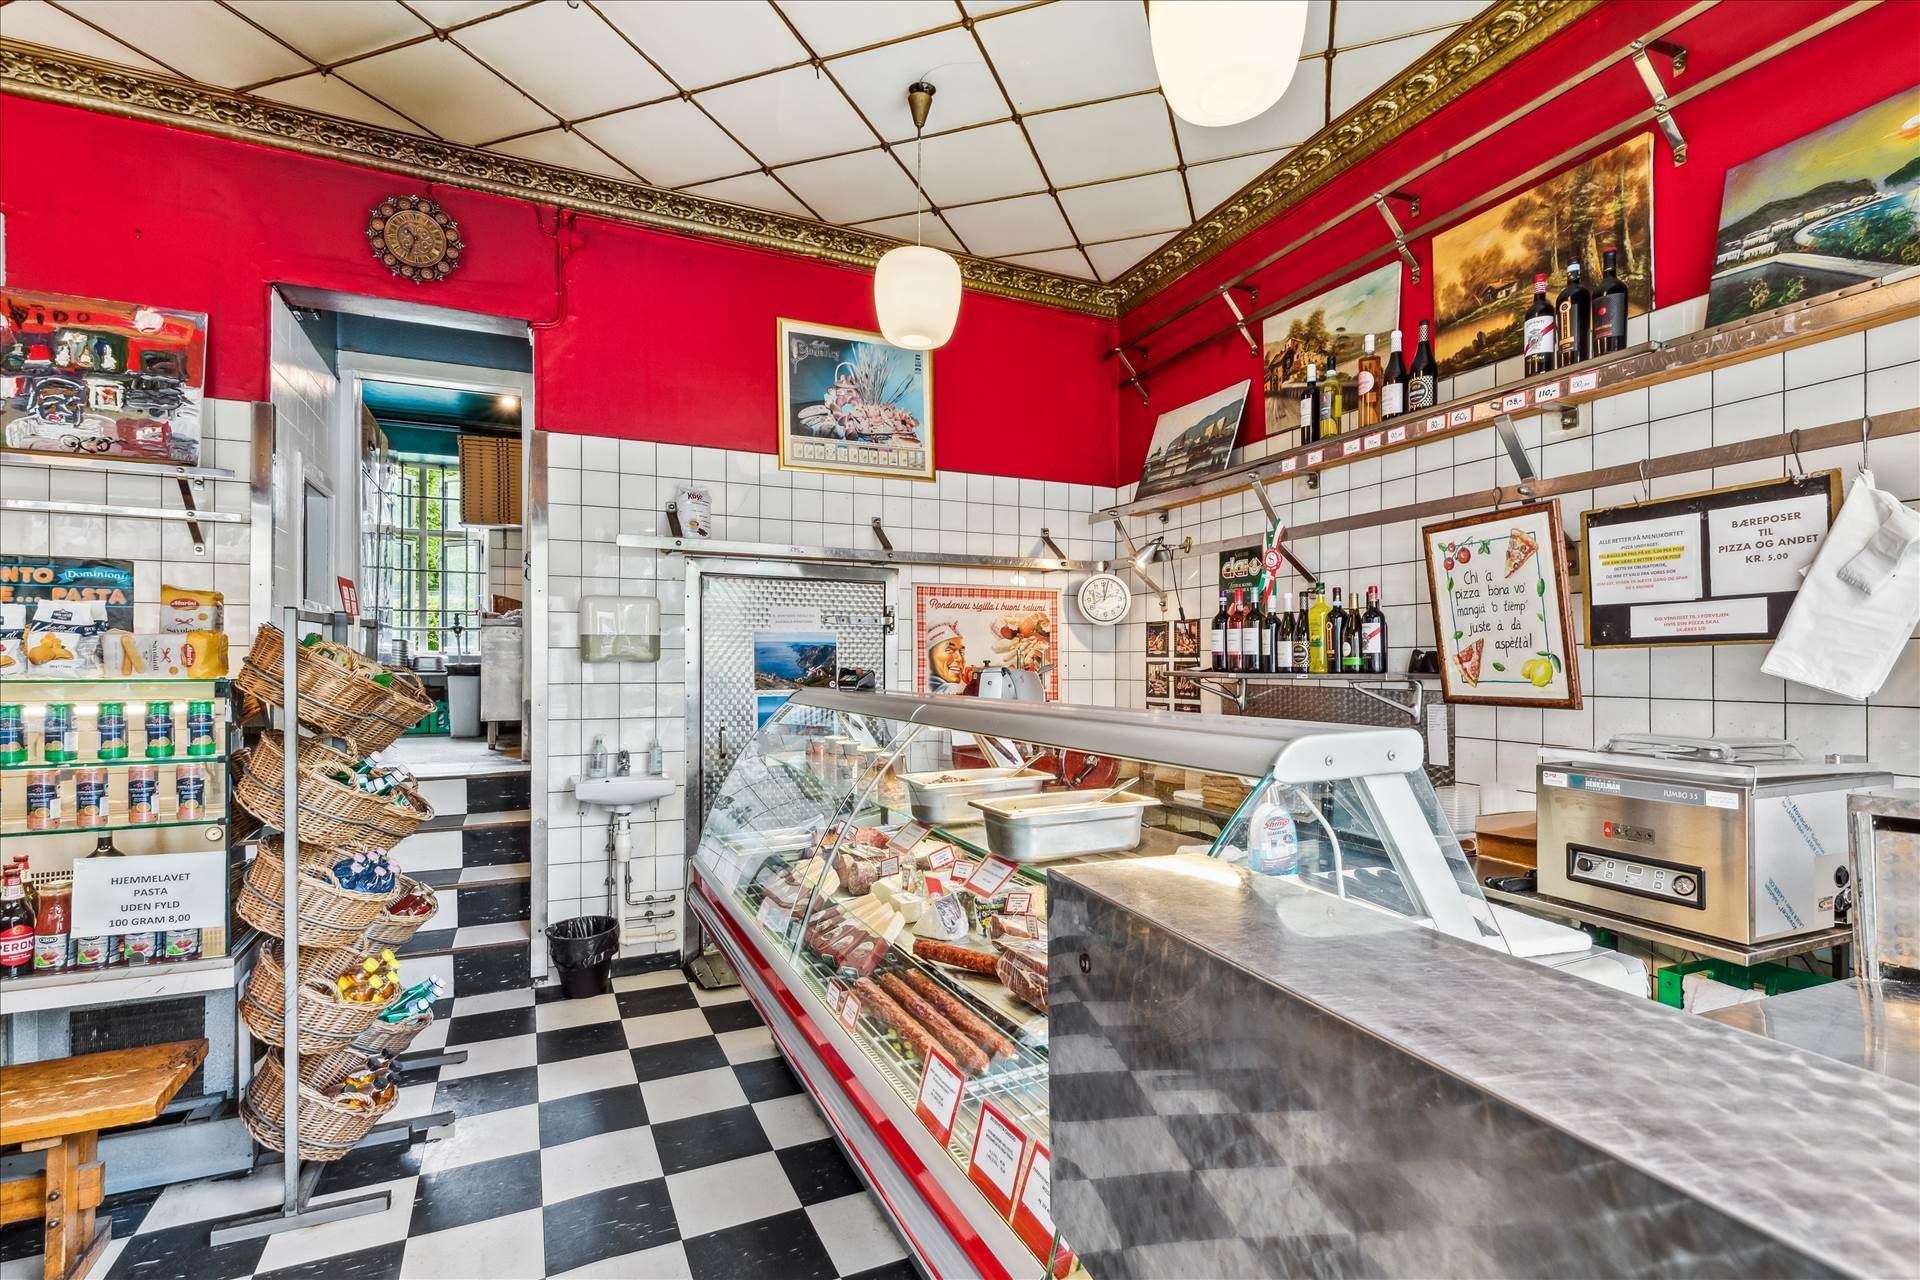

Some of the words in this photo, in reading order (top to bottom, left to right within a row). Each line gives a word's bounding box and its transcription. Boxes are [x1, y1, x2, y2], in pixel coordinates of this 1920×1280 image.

[1731, 511, 1801, 528] BÆREPOSER
[1642, 530, 1684, 541] MENUKORTET
[1758, 528, 1773, 536] TIL
[1718, 542, 1751, 553] PIZZA
[1755, 539, 1774, 549] OG
[1778, 534, 1818, 546] ANDET
[1745, 555, 1764, 563] KR.
[1768, 552, 1788, 561] 5,00
[0, 566, 54, 583] NTO
[1463, 569, 1479, 585] Chi
[52, 587, 126, 605] PASTA
[1455, 588, 1480, 606] pizza
[929, 598, 970, 610] Rondanini
[973, 600, 994, 612] sigilla
[1001, 602, 1020, 611] buoni
[1022, 603, 1046, 612] salumi
[1468, 621, 1491, 637] juste
[1585, 780, 1620, 790] HENKELMAN
[1663, 789, 1688, 800] JUMBO
[111, 873, 191, 885] HJEMMELAVET
[134, 888, 168, 896] PASTA
[120, 902, 151, 912] UDEN
[154, 901, 180, 910] FYLD
[109, 919, 128, 928] 100
[131, 916, 165, 926] GRAM
[168, 914, 191, 923] 8,00
